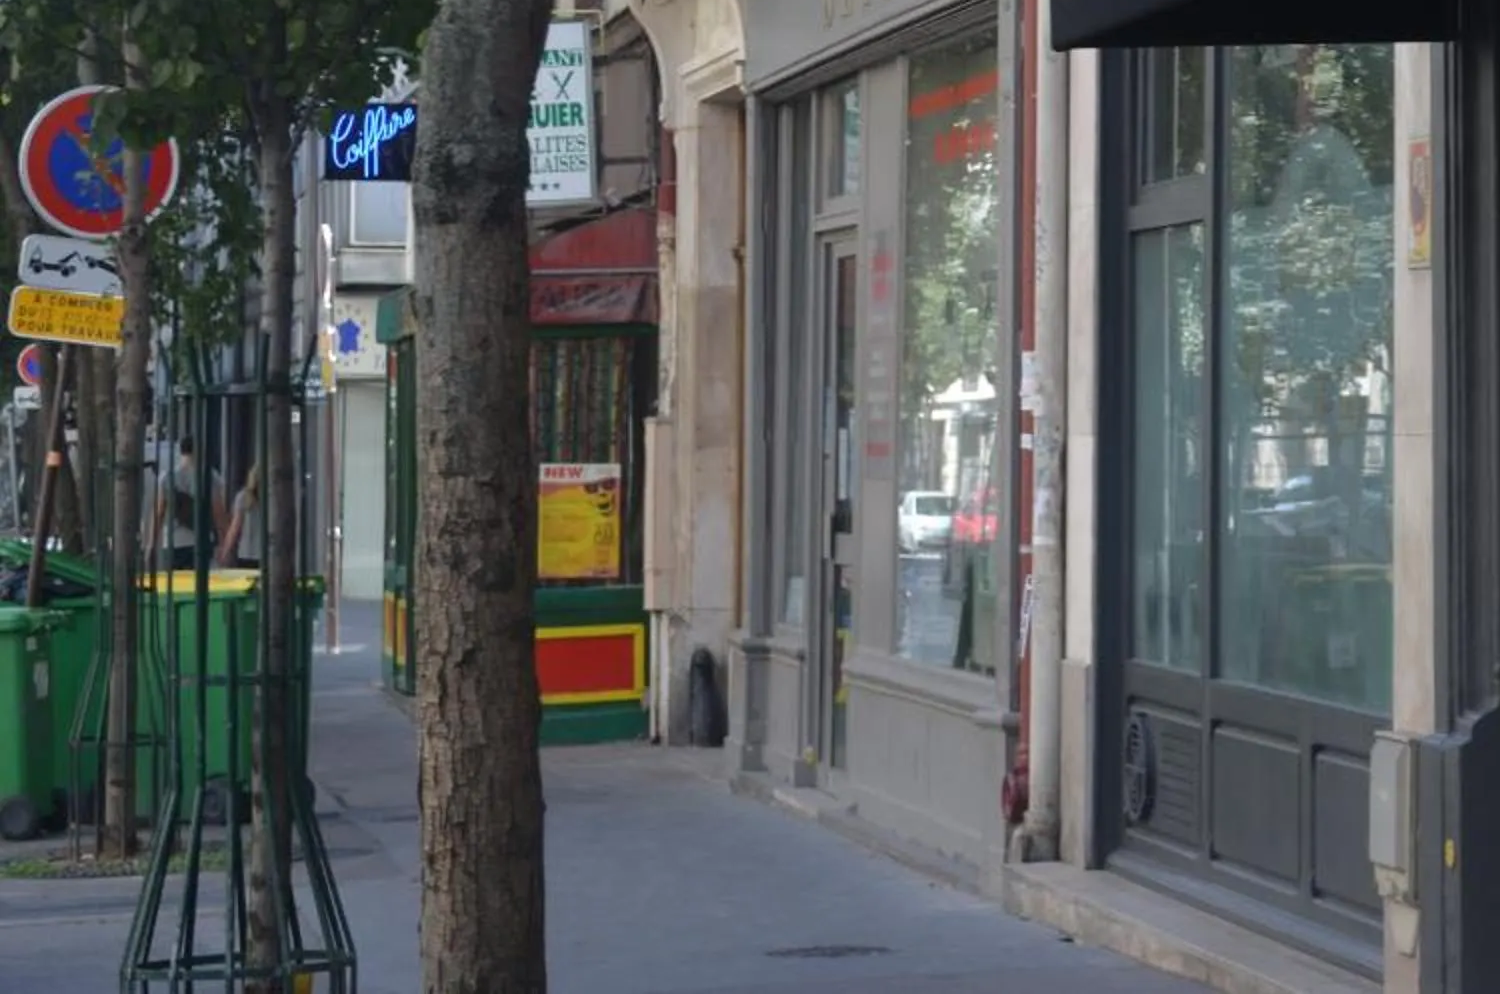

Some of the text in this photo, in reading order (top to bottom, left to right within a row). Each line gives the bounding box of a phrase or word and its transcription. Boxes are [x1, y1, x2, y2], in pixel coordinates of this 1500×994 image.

[543, 48, 583, 67] ANT
[330, 105, 415, 178] Coiffure
[543, 466, 583, 480] NEW
